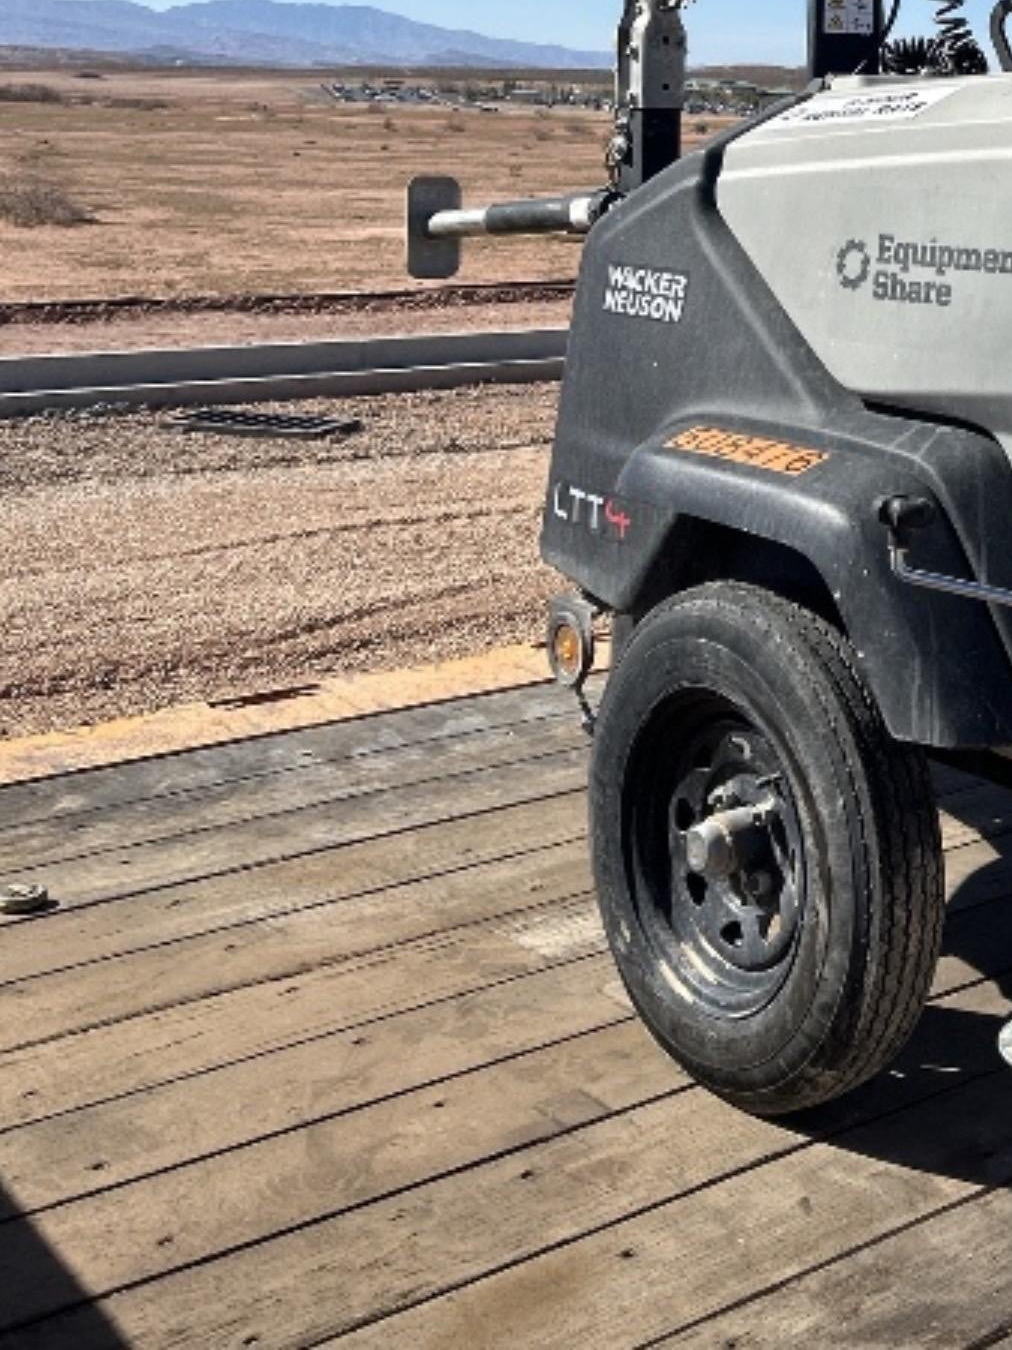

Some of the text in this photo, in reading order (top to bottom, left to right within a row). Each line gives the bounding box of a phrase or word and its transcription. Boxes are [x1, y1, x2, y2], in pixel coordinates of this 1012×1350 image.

[608, 263, 688, 299] WACKER
[872, 269, 953, 307] Share
[602, 286, 685, 323] NEUSON
[553, 481, 631, 539] LTT4
